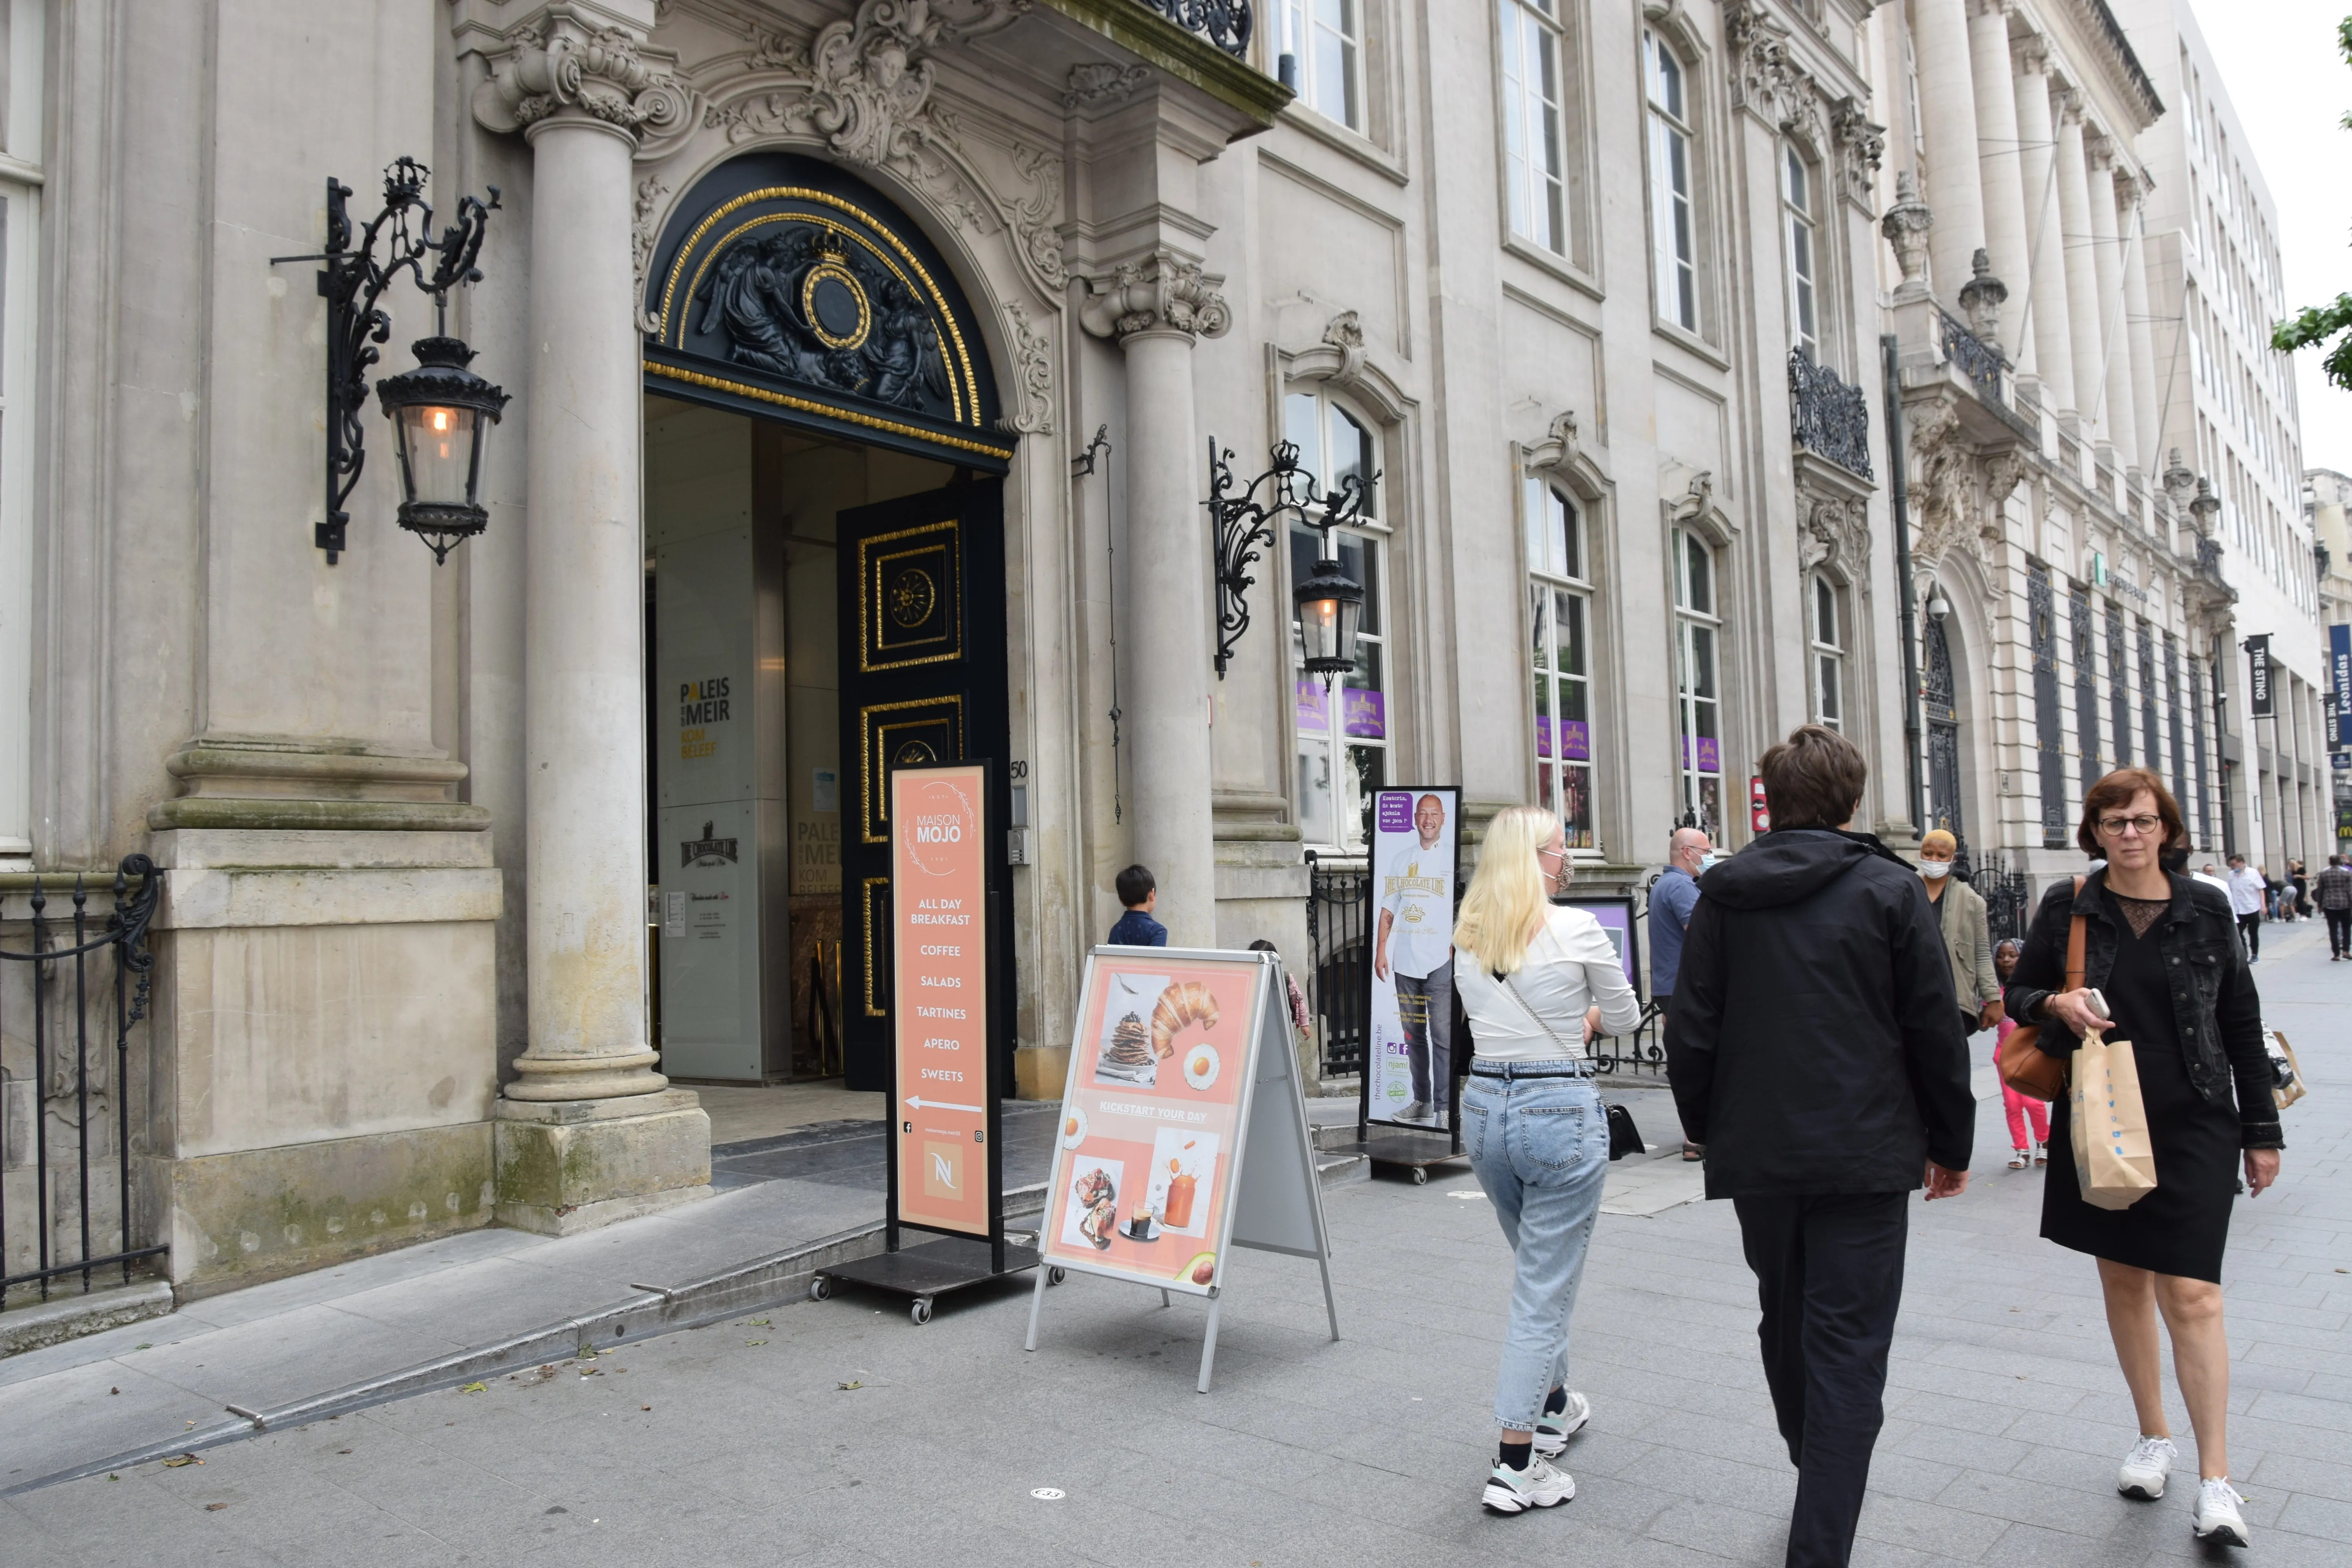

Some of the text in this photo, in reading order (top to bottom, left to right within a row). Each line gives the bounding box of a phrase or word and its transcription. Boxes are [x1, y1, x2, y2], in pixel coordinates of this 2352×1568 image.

[2254, 648, 2266, 700] THE STING
[680, 677, 730, 703] PALEIS
[2335, 654, 2351, 715] Leonidas
[686, 699, 730, 726] MEIR
[2328, 703, 2337, 742] THE STING
[681, 728, 705, 744] KOM
[681, 742, 717, 760] BELEEF
[1011, 760, 1028, 779] 50
[917, 814, 960, 826] MAISON
[798, 822, 839, 842] PALE
[917, 826, 961, 843] MOJO
[805, 844, 841, 865] MEI
[799, 869, 827, 882] KOM
[1384, 877, 1445, 896] THE CHOCOLATE LINE
[918, 899, 962, 909] ALL DAY
[911, 914, 970, 925] BREAKFAST
[920, 945, 961, 956] COFFEE
[921, 975, 961, 988] SALADS
[916, 1006, 966, 1020] TARTINES
[924, 1038, 960, 1051] APERO
[1388, 1060, 1408, 1070] njam!
[921, 1068, 963, 1082] SWEETS
[1100, 1100, 1207, 1123] KICKSTART YOUR DAY
